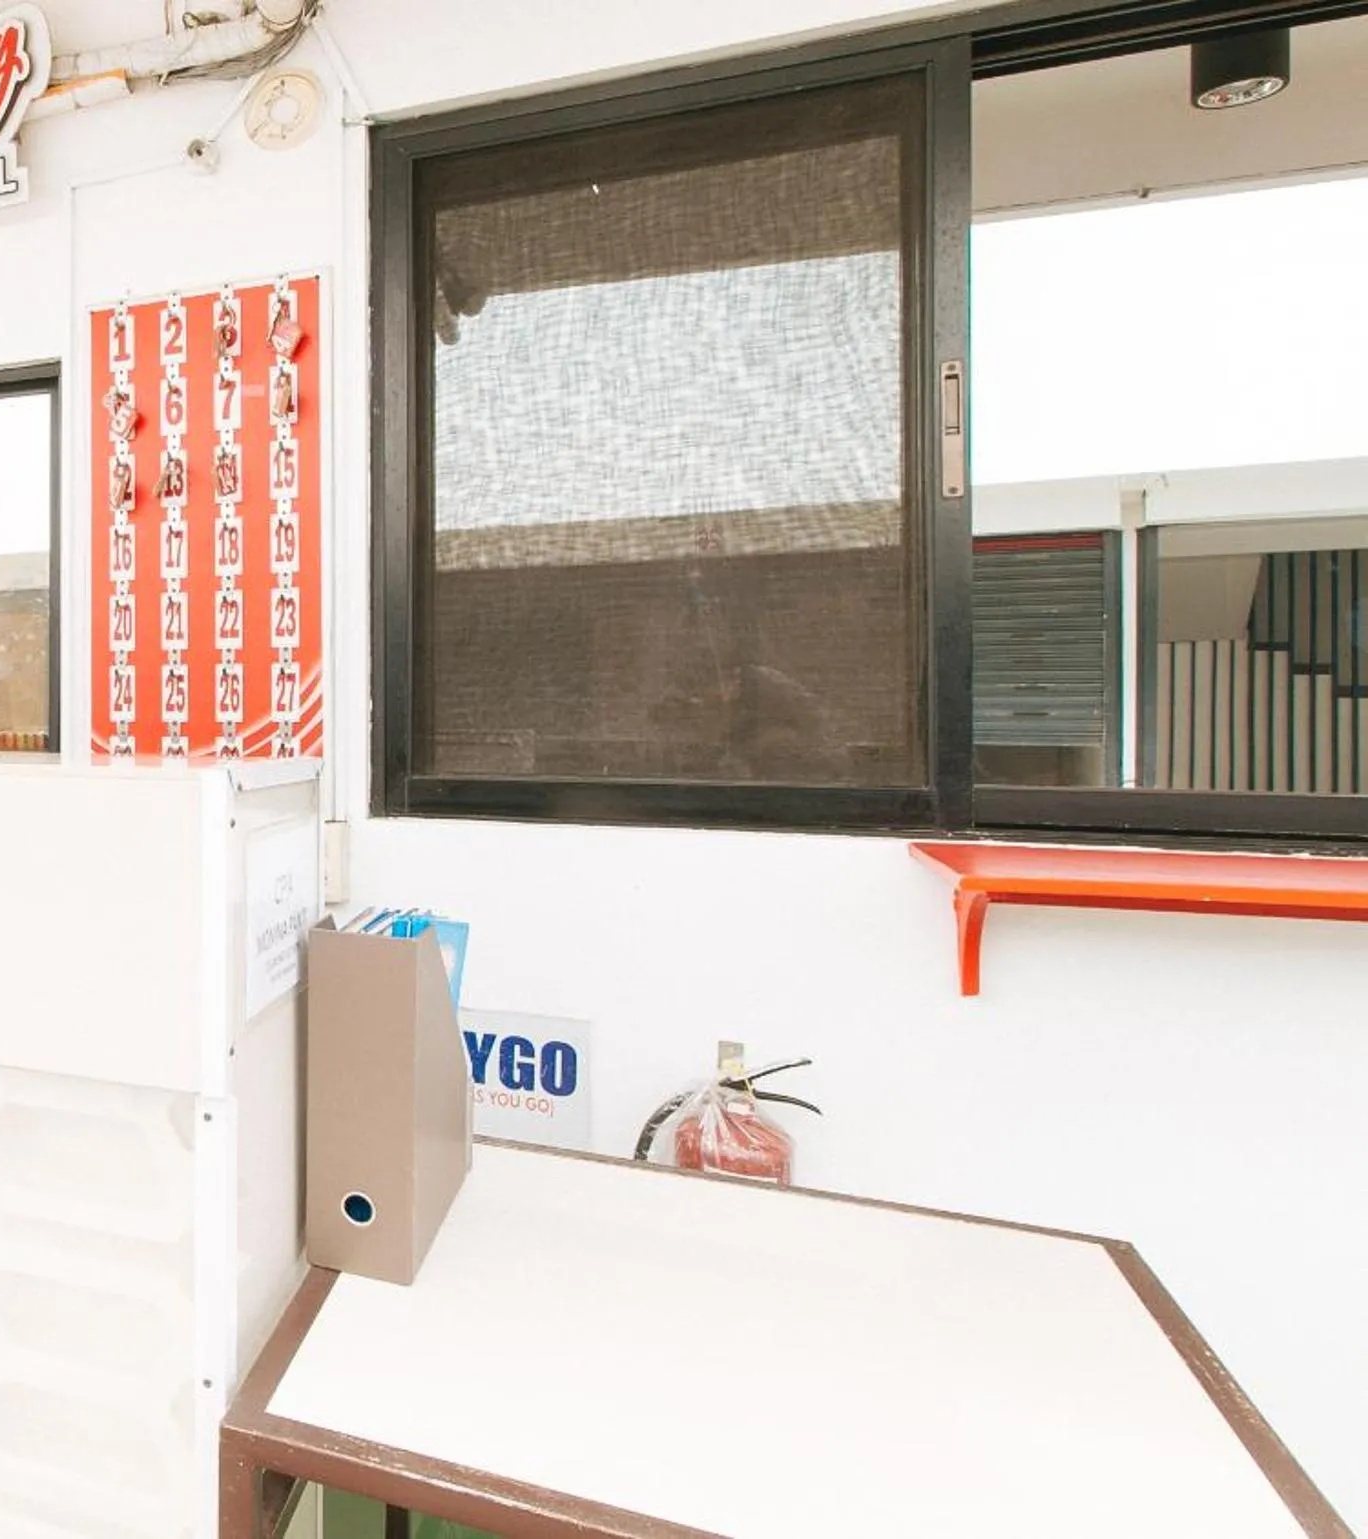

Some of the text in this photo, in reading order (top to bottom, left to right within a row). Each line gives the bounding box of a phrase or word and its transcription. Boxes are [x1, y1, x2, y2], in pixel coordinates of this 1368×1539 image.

[113, 323, 131, 362] 1
[164, 316, 183, 355] 2
[164, 384, 184, 425] 6
[218, 380, 237, 420] 7
[273, 448, 295, 489] 15
[113, 521, 296, 572] 16 17 18 19
[113, 597, 297, 641] 20 21 22 23
[113, 672, 296, 712] 24 25 26 27
[463, 1030, 578, 1097] YGO
[489, 1091, 520, 1109] YOU
